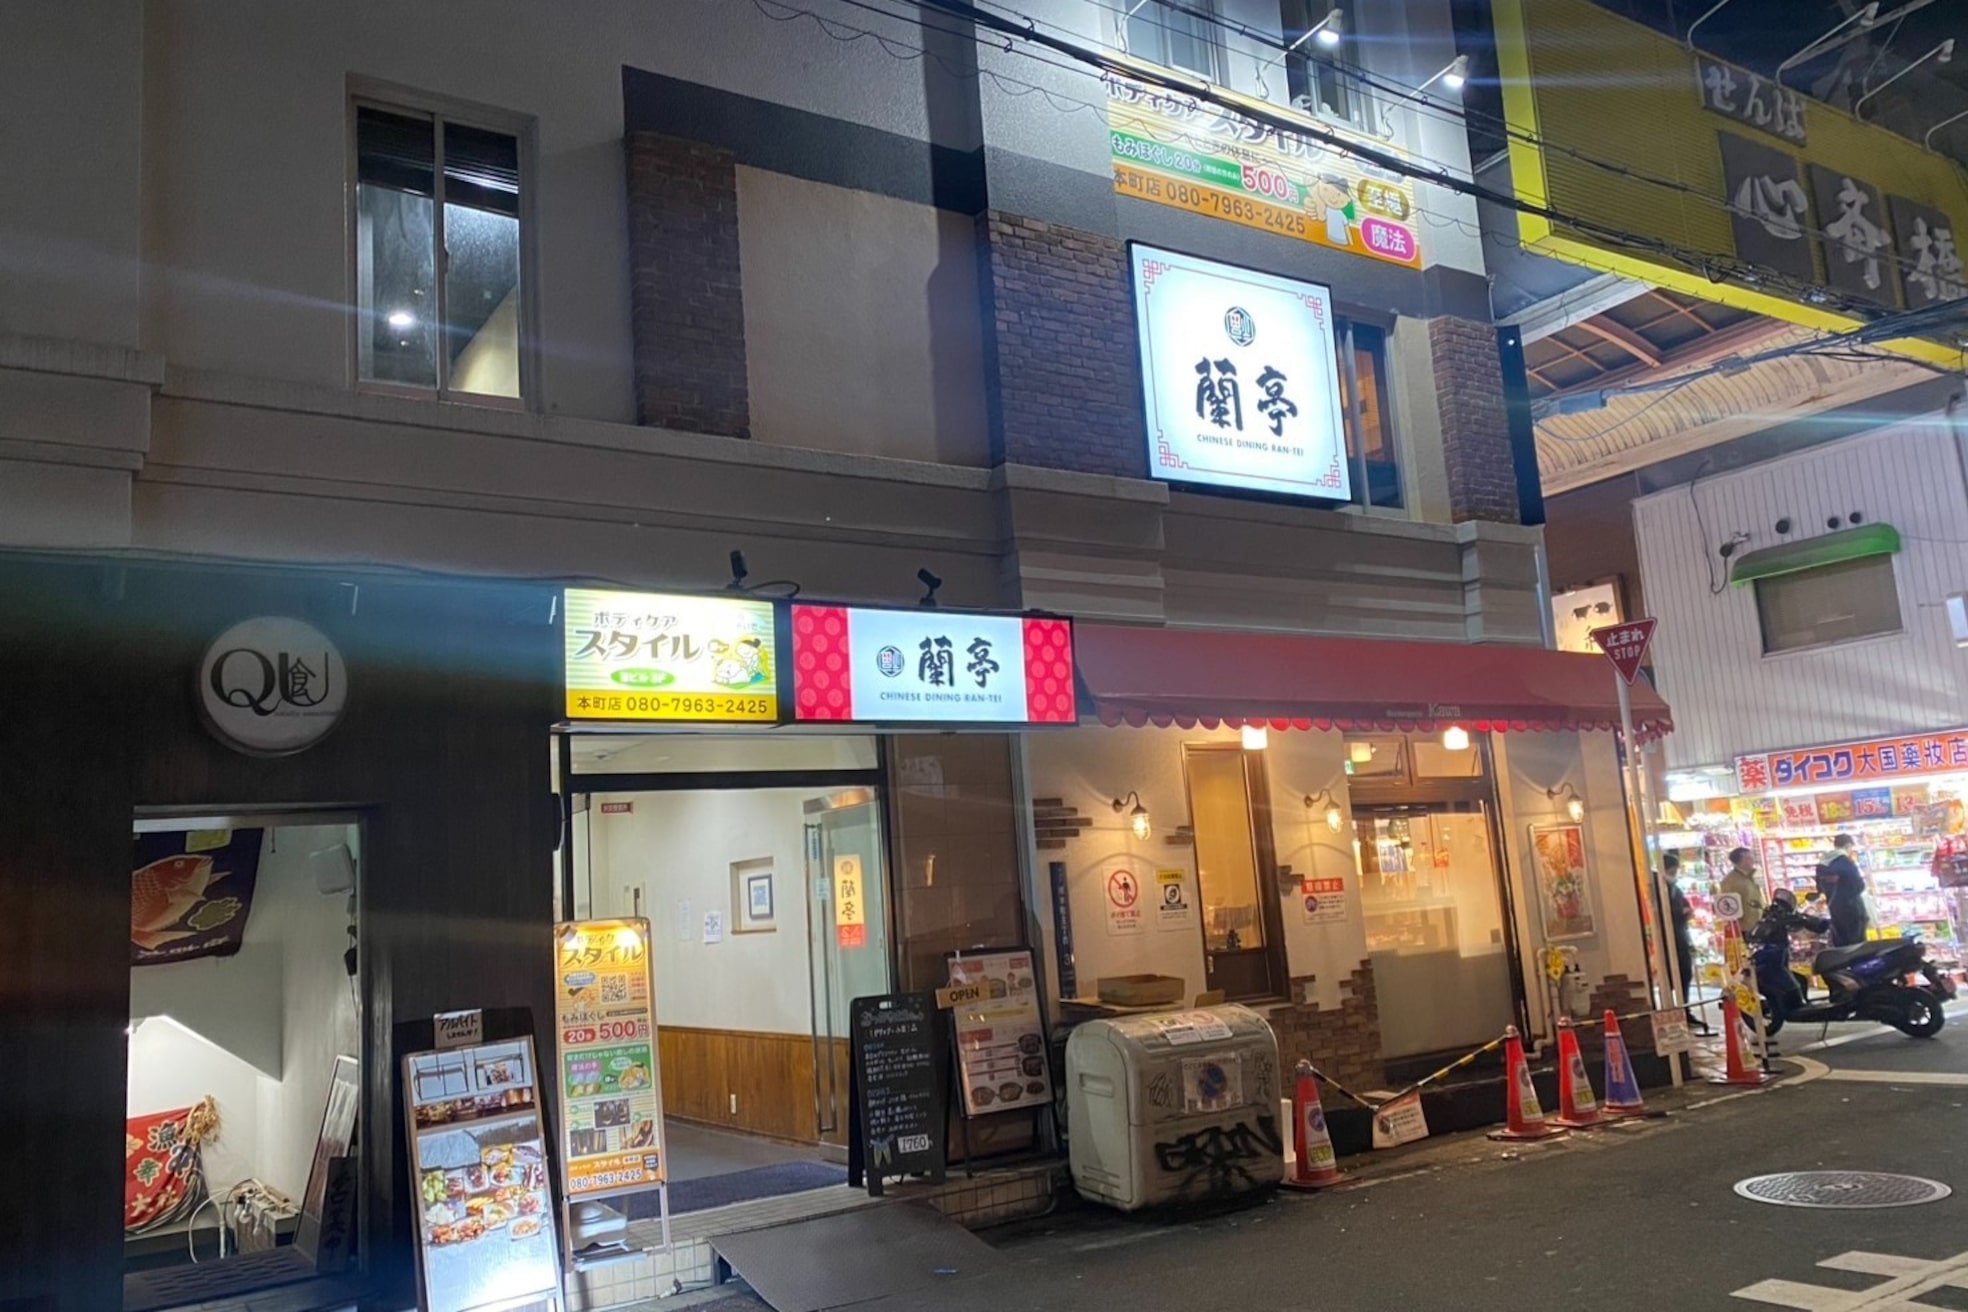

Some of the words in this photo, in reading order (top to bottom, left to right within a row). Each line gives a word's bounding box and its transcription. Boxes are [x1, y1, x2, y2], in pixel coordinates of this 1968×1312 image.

[1112, 168, 1162, 199] 本町店
[1166, 181, 1306, 235] 080-7963-2425
[1371, 224, 1407, 254] 魔法
[1195, 356, 1299, 437] 蘭亭
[1197, 433, 1233, 447] CHINESE
[1237, 438, 1269, 451] DINING
[1271, 443, 1304, 457] RAN-TEI
[594, 612, 678, 630] ボディケア
[574, 630, 702, 662] スタイル
[1606, 627, 1645, 648] 止まれ
[917, 635, 1001, 689] 蘭亭
[1614, 644, 1641, 660] STOP
[577, 696, 622, 711] 本町店
[626, 696, 768, 714] 080-7963-2425
[880, 691, 921, 702] CHINESE
[925, 692, 961, 703] DINING
[965, 693, 1002, 704] RAN-TEI
[1739, 756, 1769, 790] 薬
[1774, 750, 1855, 783] ダイコク
[840, 879, 857, 921] 蘭亭
[563, 944, 644, 966] スタイル
[949, 987, 980, 1002] OPEN
[600, 1020, 649, 1040] 500円
